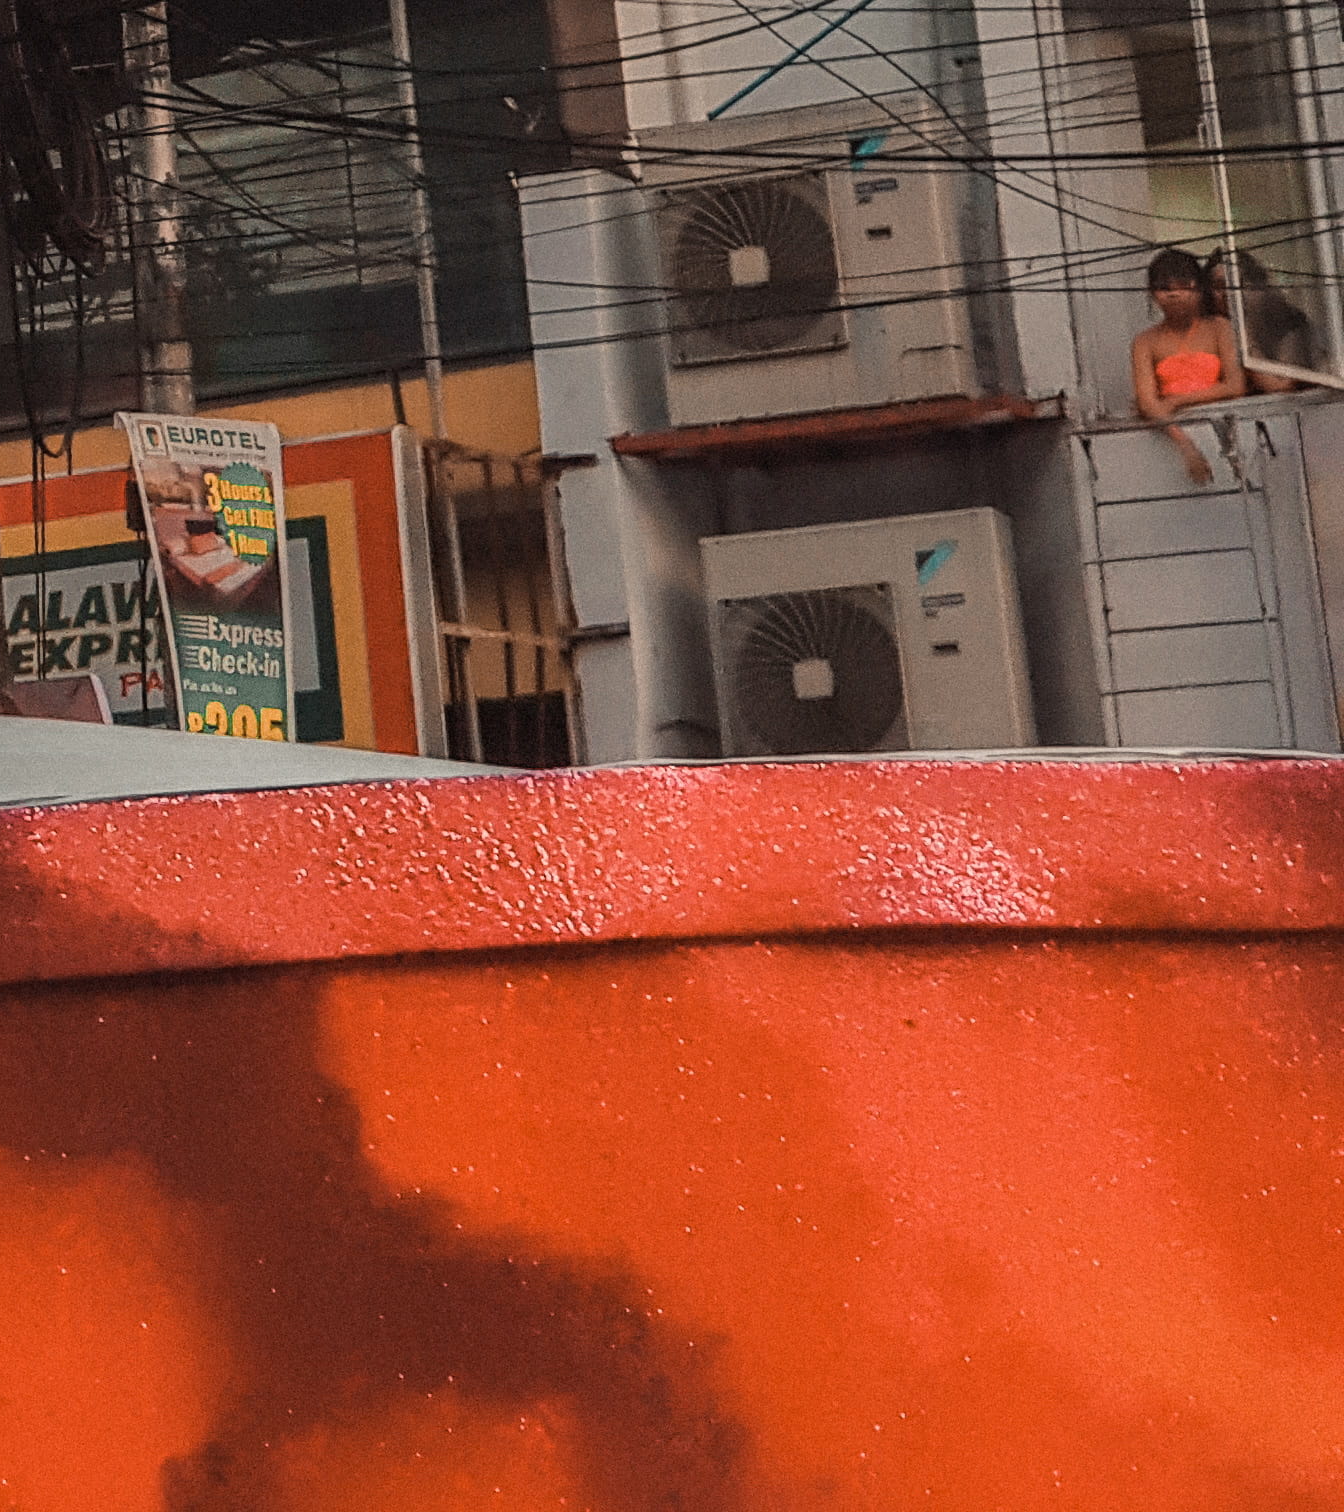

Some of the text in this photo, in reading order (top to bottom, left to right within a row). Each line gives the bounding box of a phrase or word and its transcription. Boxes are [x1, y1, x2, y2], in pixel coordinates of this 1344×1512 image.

[167, 425, 266, 451] EUROTEL
[204, 473, 223, 513] 3
[207, 615, 284, 648] Express
[197, 646, 280, 679] Check-in
